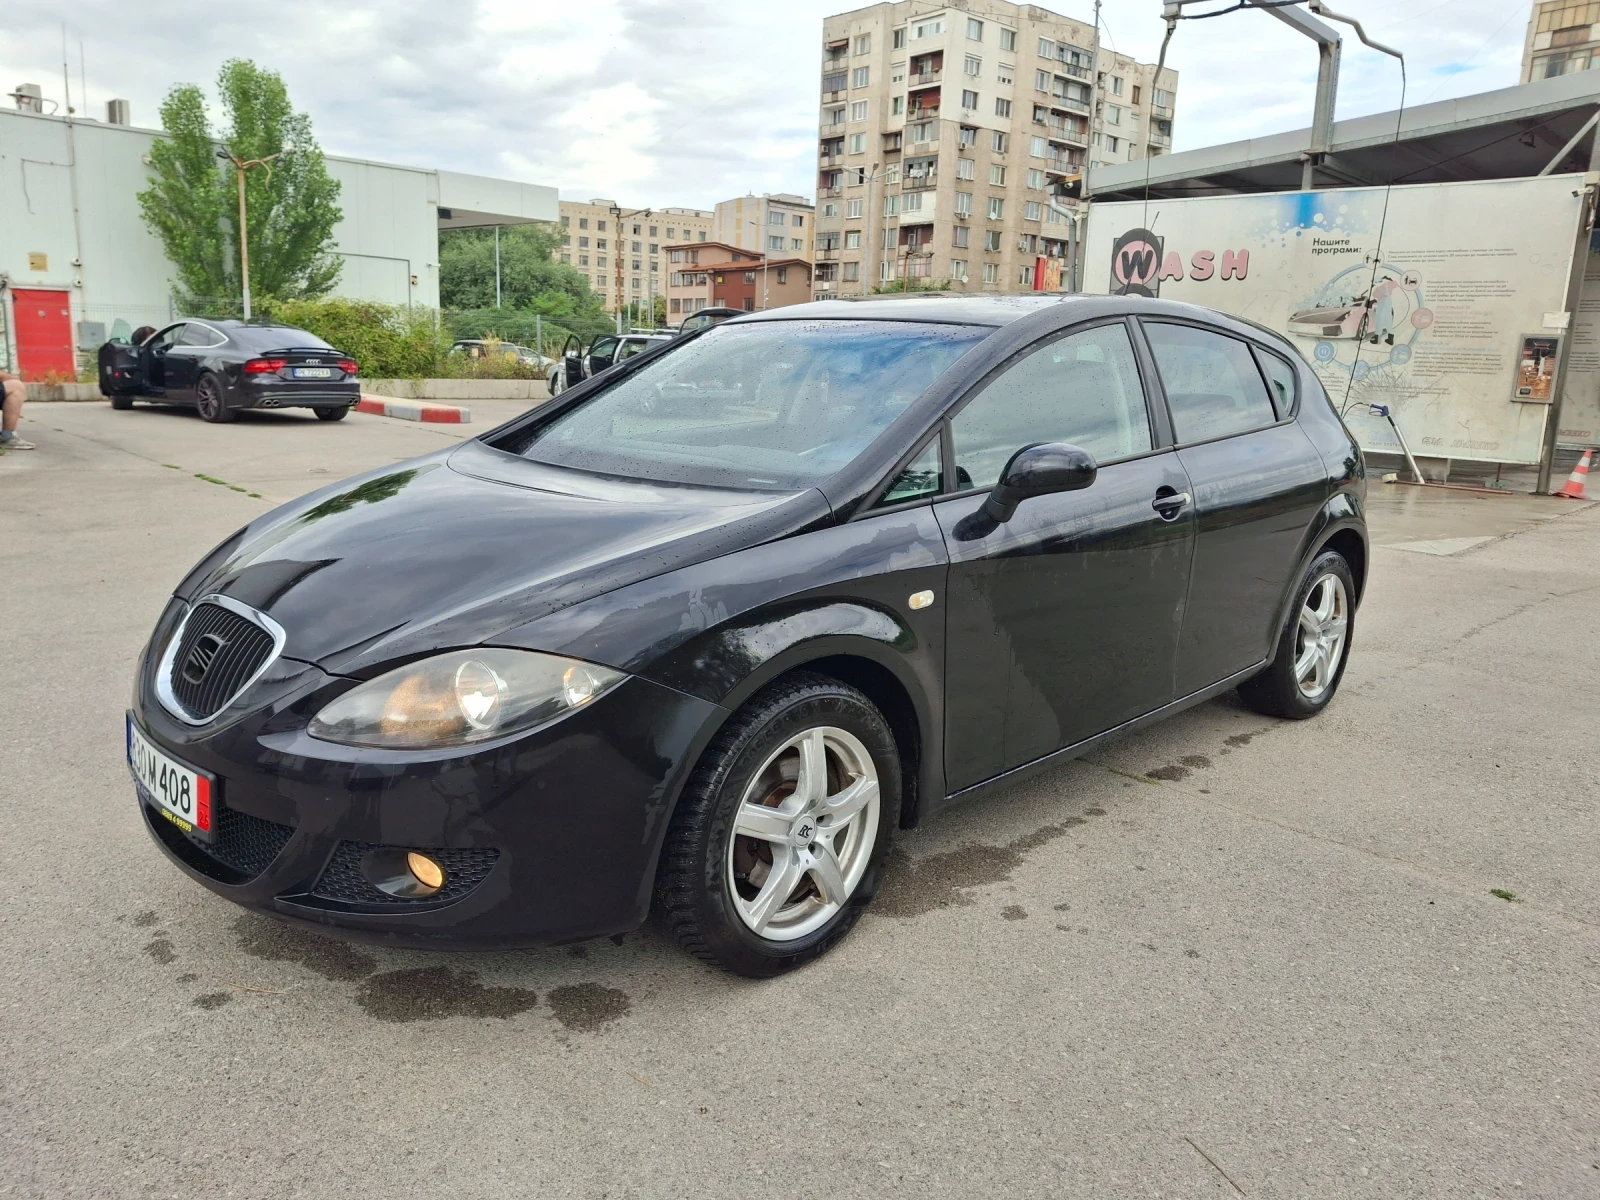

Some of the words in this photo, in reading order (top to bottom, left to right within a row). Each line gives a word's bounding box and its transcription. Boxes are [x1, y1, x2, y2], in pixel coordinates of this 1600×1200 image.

[1311, 245, 1363, 256] програми:
[1312, 237, 1351, 247] Нашите
[1120, 248, 1250, 282] WASH
[159, 762, 191, 815] 408
